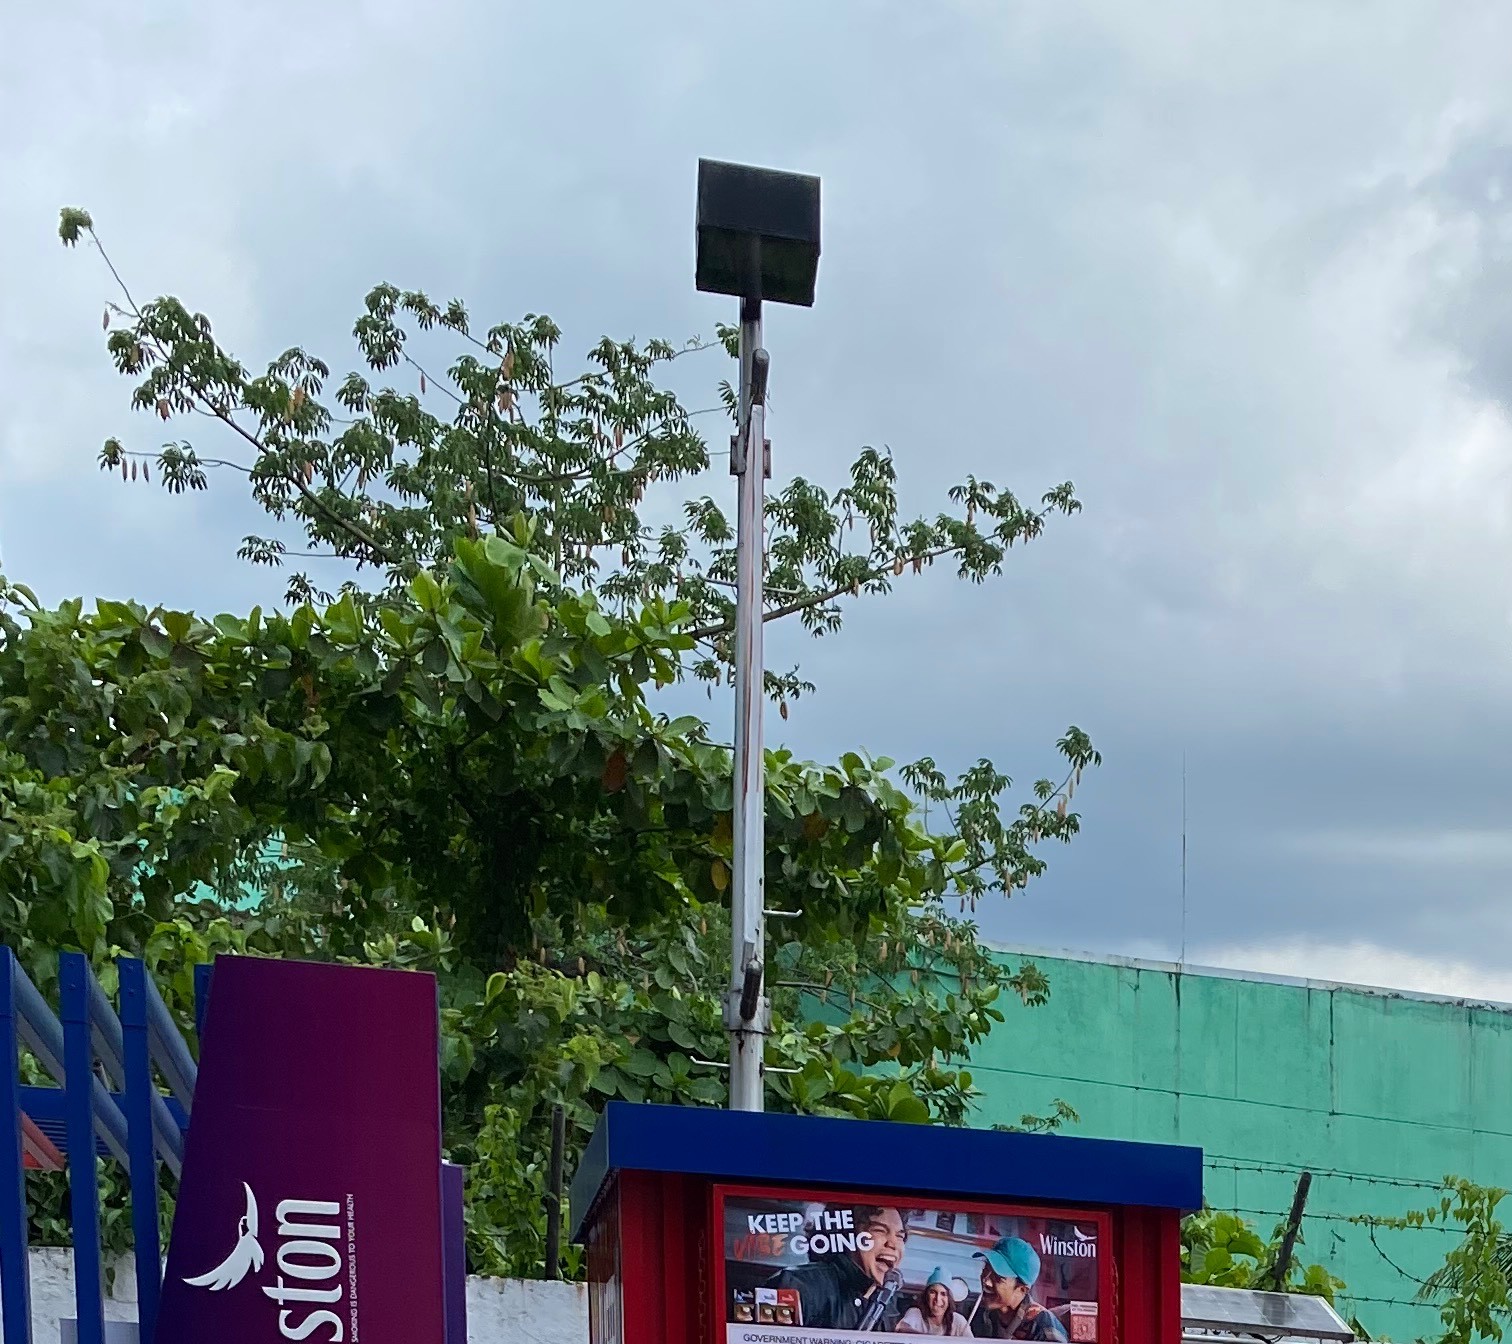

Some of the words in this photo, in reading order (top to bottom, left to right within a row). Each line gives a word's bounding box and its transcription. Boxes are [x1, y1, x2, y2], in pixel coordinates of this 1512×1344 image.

[345, 1194, 354, 1221] HEALTH
[347, 1221, 355, 1242] YOUR
[747, 1212, 804, 1235] KEEP
[810, 1209, 855, 1231] THE
[789, 1231, 875, 1255] GOING
[1039, 1232, 1097, 1258] Winston
[348, 1254, 357, 1300] DANGEROUS
[350, 1308, 359, 1342] SMOKING
